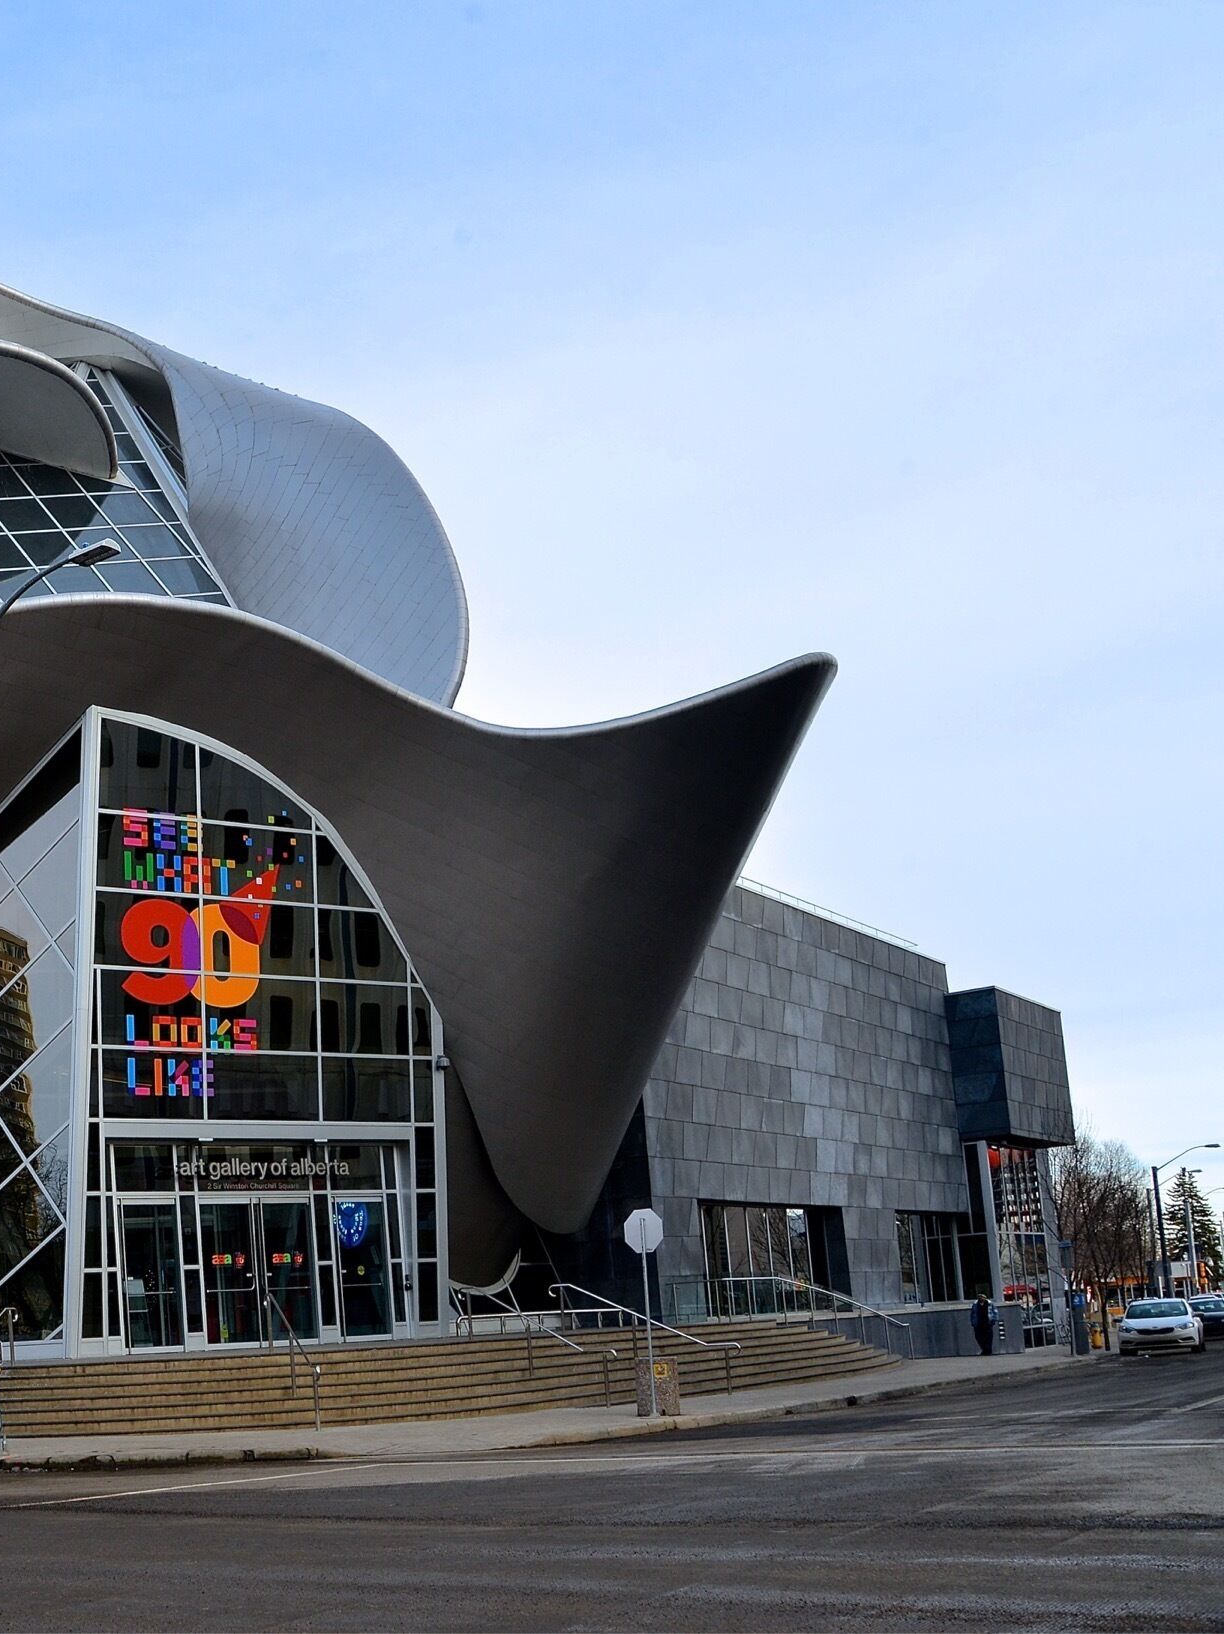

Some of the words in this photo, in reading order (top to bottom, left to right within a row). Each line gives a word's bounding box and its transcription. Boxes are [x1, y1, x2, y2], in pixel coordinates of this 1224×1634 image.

[123, 807, 204, 852] SEE
[124, 850, 236, 896] WHAT
[120, 898, 260, 1008] 90
[126, 1014, 258, 1054] LOOKS
[127, 1056, 216, 1097] LIKE
[180, 1158, 206, 1176] art
[209, 1158, 267, 1180] gallery
[270, 1158, 288, 1176] of
[290, 1158, 350, 1176] alberta
[207, 1182, 212, 1190] 2
[213, 1182, 222, 1190] Sir
